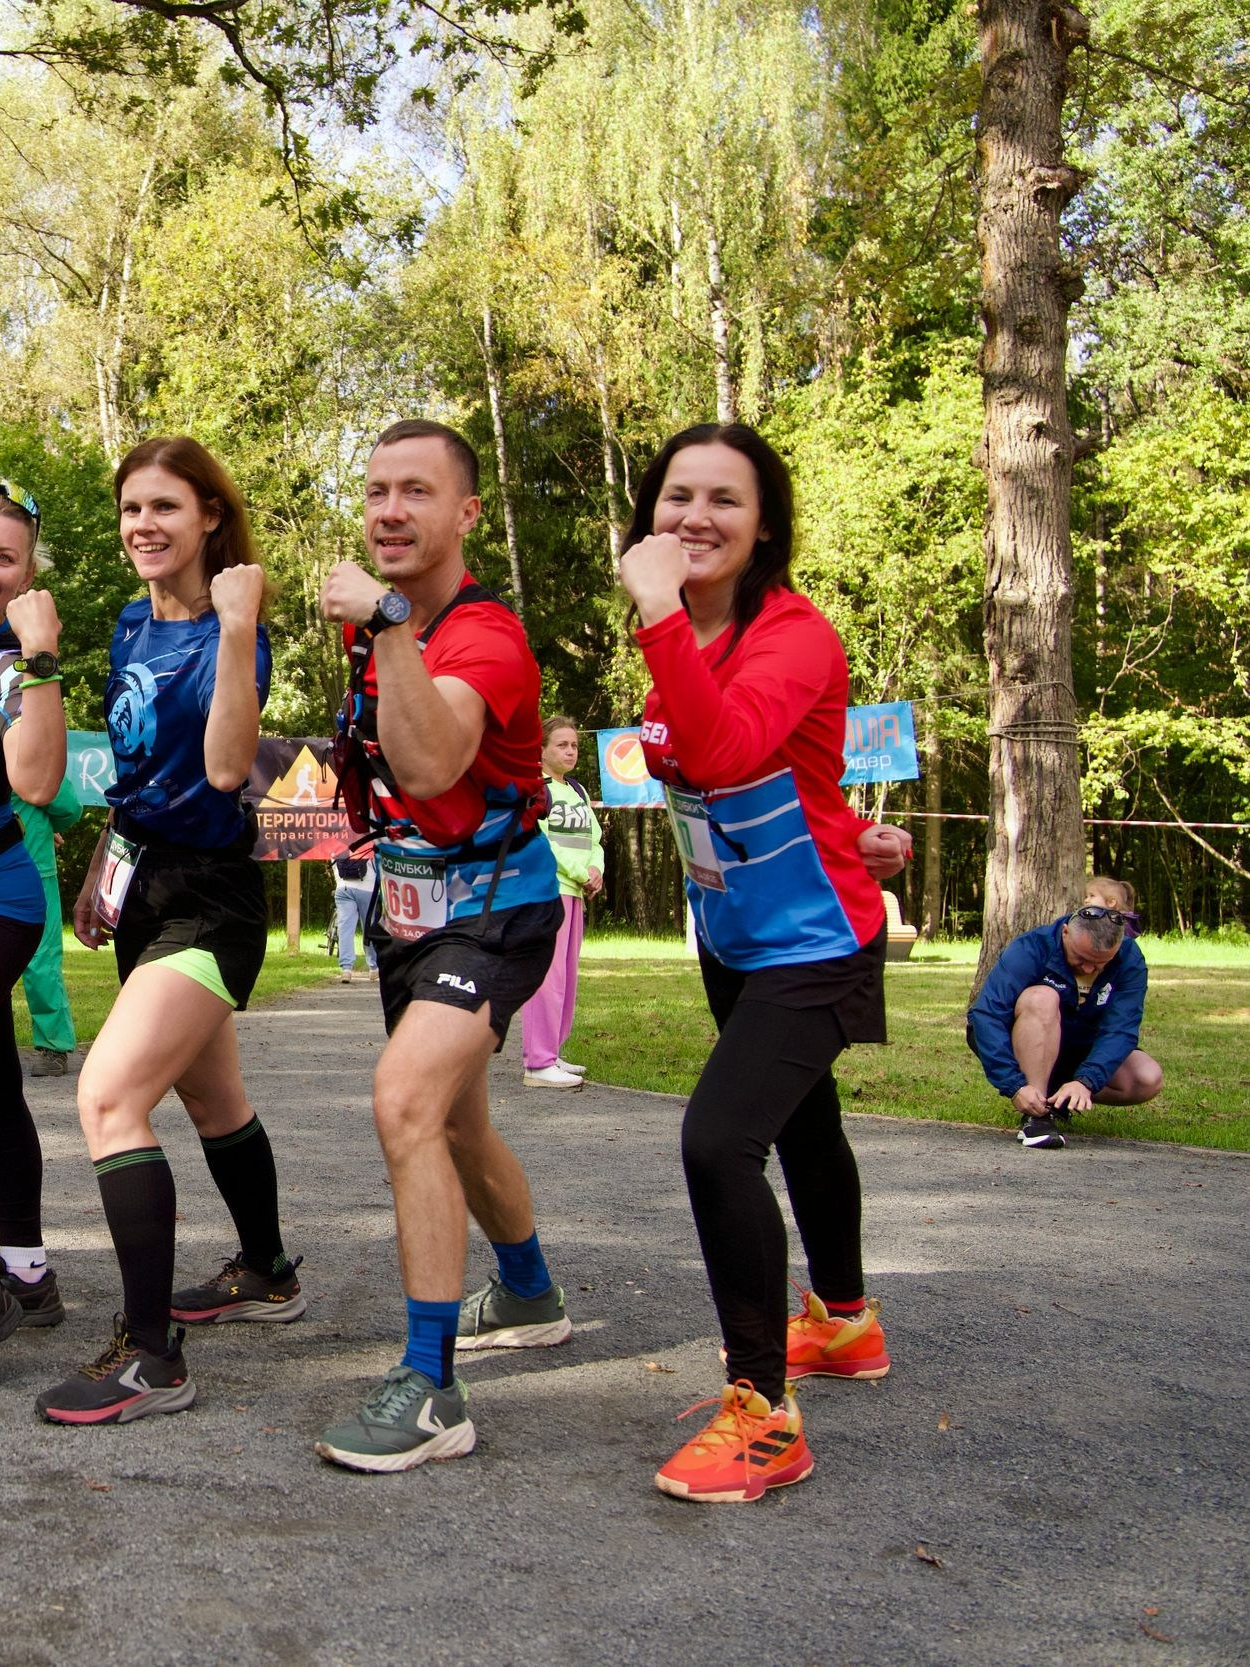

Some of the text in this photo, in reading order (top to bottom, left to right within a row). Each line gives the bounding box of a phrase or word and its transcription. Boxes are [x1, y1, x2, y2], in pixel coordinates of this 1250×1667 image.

[845, 755, 892, 771] йдер
[256, 813, 350, 828] ТЕРРИТОРИ
[264, 830, 349, 842] странствий
[394, 862, 433, 876] ДУБКИ
[436, 973, 477, 994] FILA
